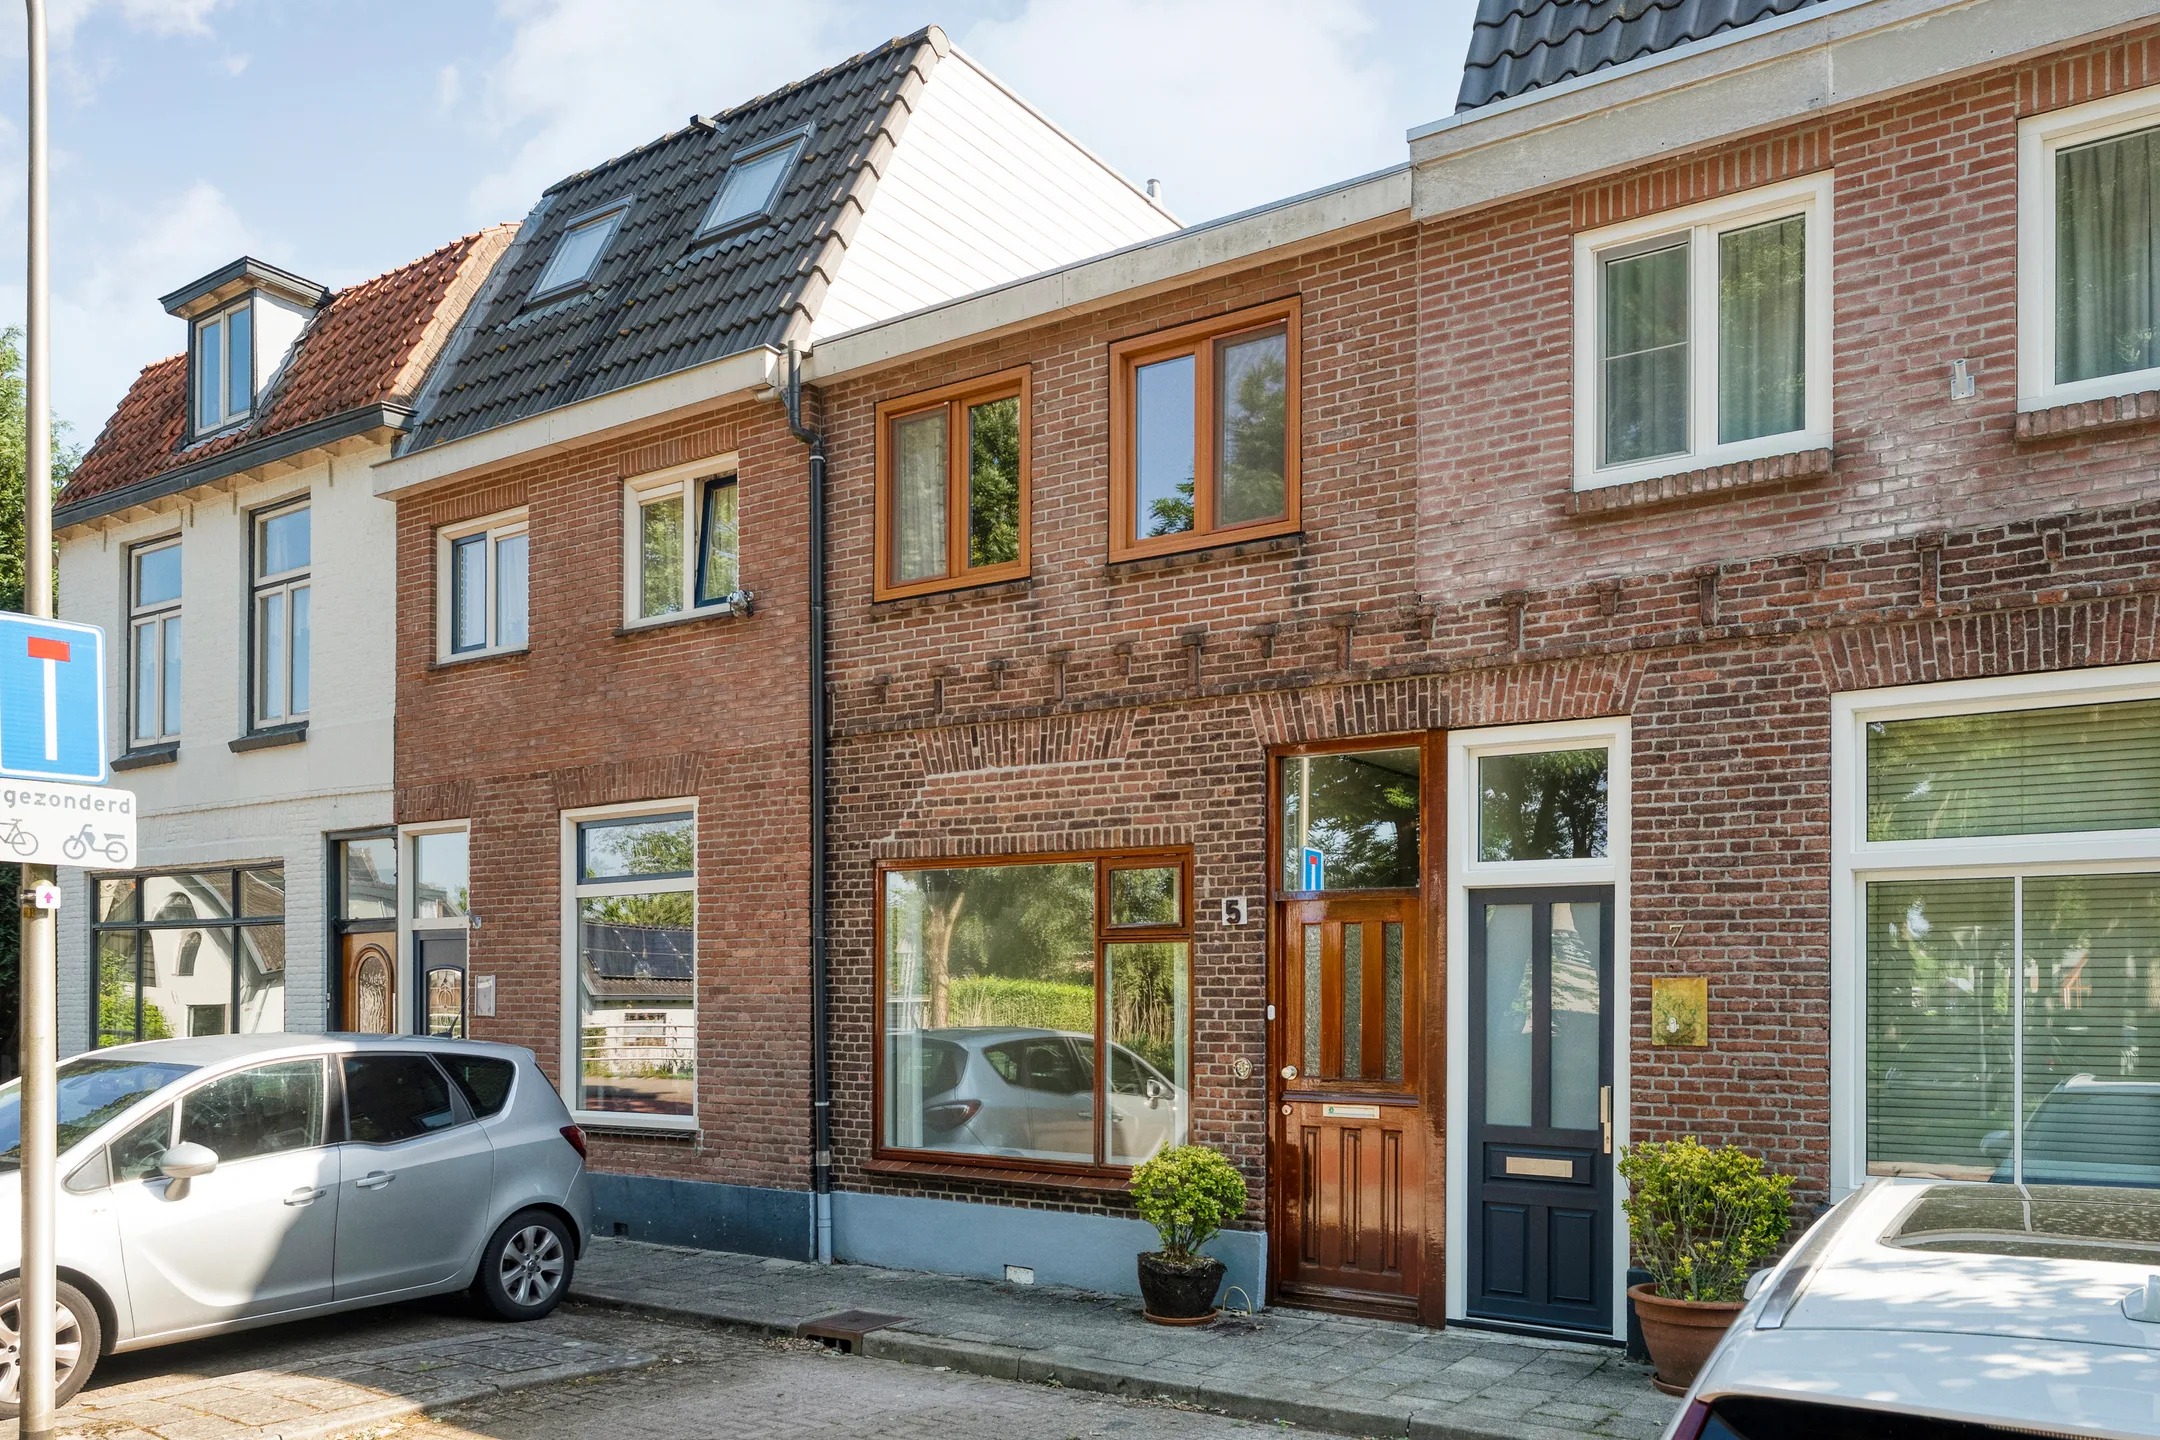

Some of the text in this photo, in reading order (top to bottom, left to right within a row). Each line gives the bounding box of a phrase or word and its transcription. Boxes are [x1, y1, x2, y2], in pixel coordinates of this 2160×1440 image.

[0, 789, 130, 814] gezonderd
[1225, 899, 1241, 924] 5
[1669, 924, 1685, 947] 7
